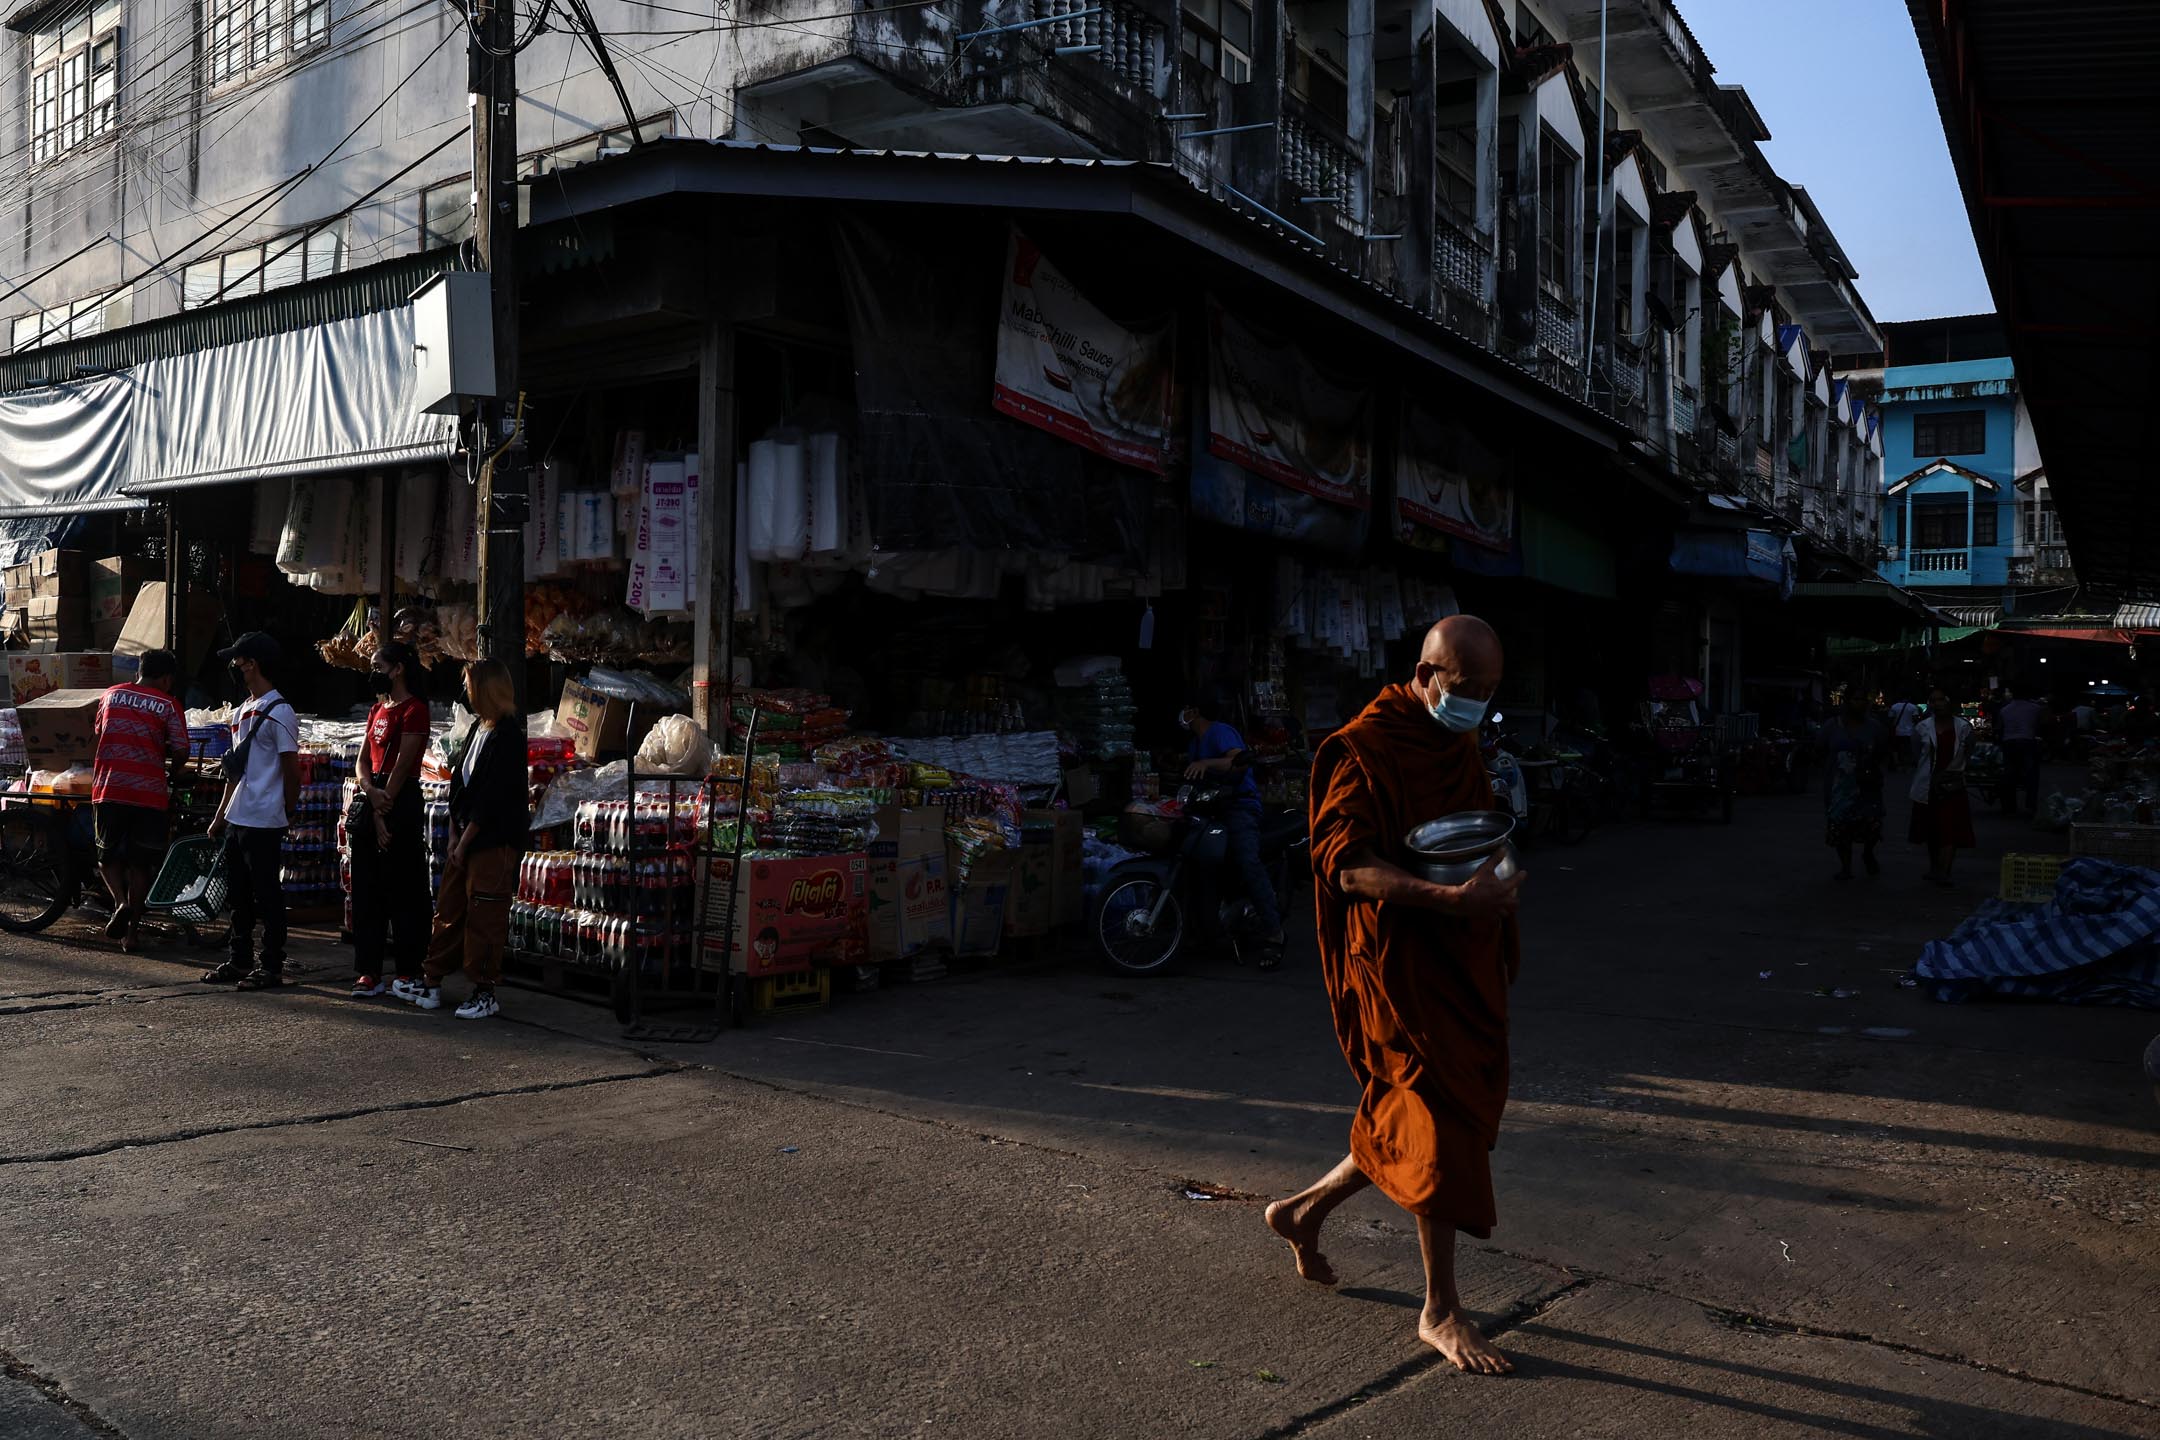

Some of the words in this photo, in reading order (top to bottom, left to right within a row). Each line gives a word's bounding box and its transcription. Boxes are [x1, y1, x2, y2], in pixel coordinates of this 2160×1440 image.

[1012, 300, 1043, 324] Mab
[1079, 340, 1113, 368] Sauce
[629, 563, 645, 606] JT-200
